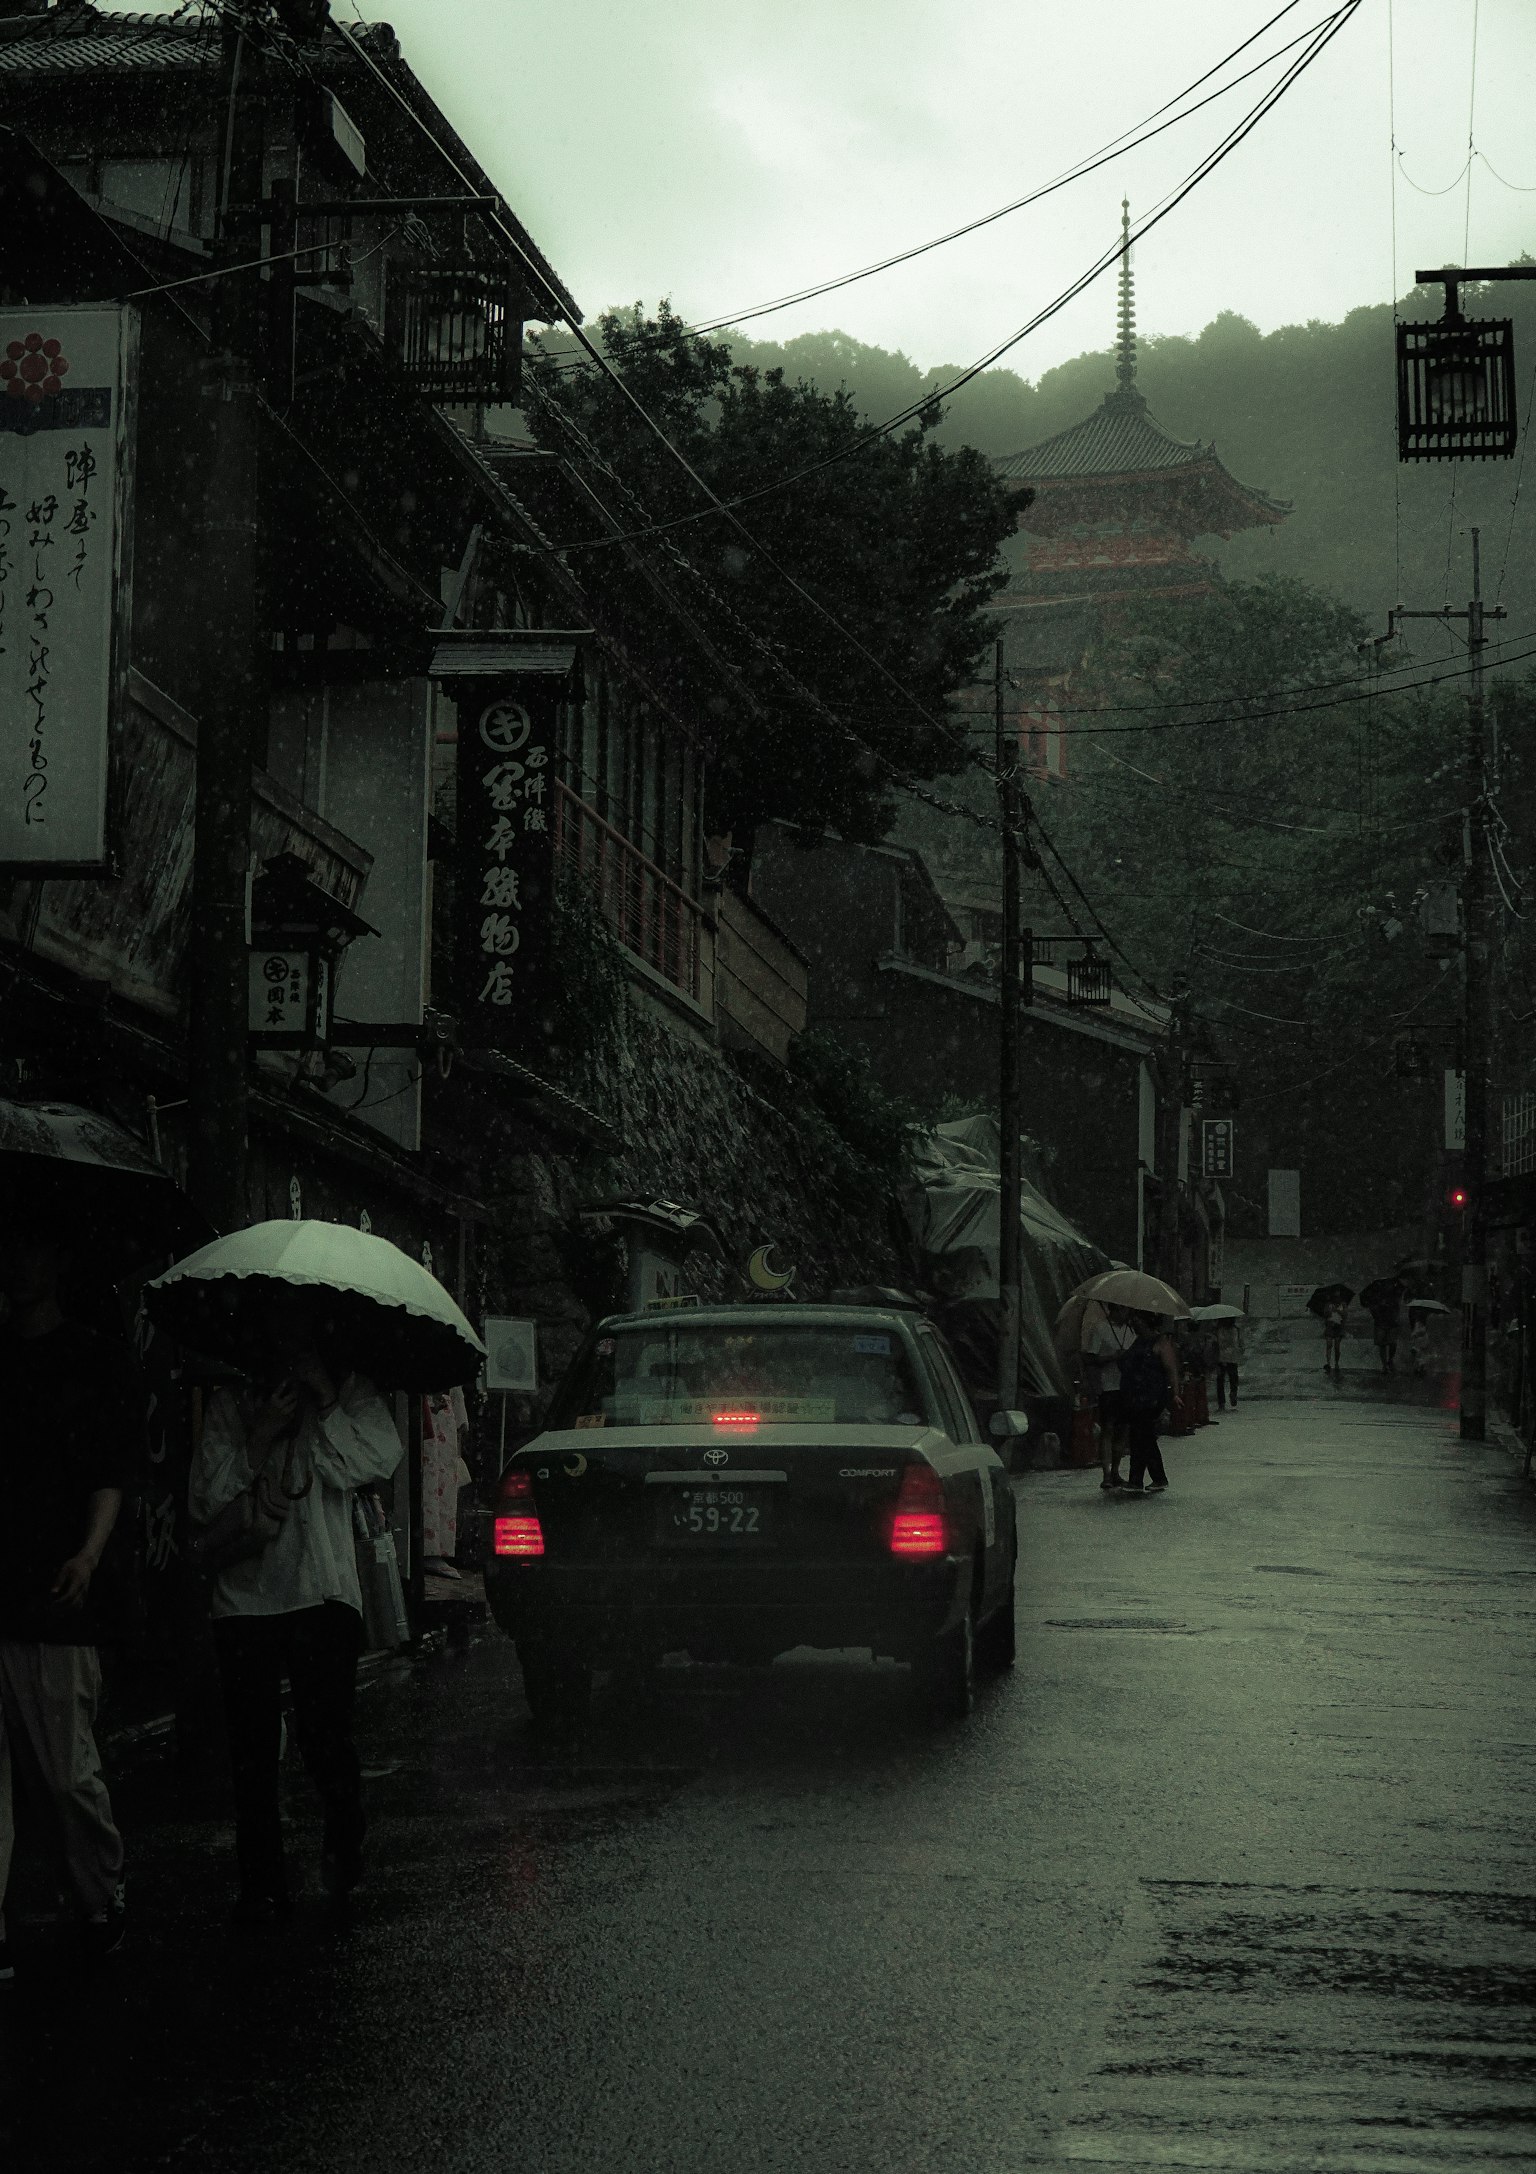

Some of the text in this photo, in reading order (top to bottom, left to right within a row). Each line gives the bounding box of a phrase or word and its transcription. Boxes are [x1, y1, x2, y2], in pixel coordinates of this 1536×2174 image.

[524, 745, 549, 833] 西陣織
[478, 760, 525, 1007] 岡本織物店
[839, 1469, 897, 1478] COMFORT
[692, 1491, 745, 1505] 京都 500
[673, 1507, 760, 1533] い 59-22
